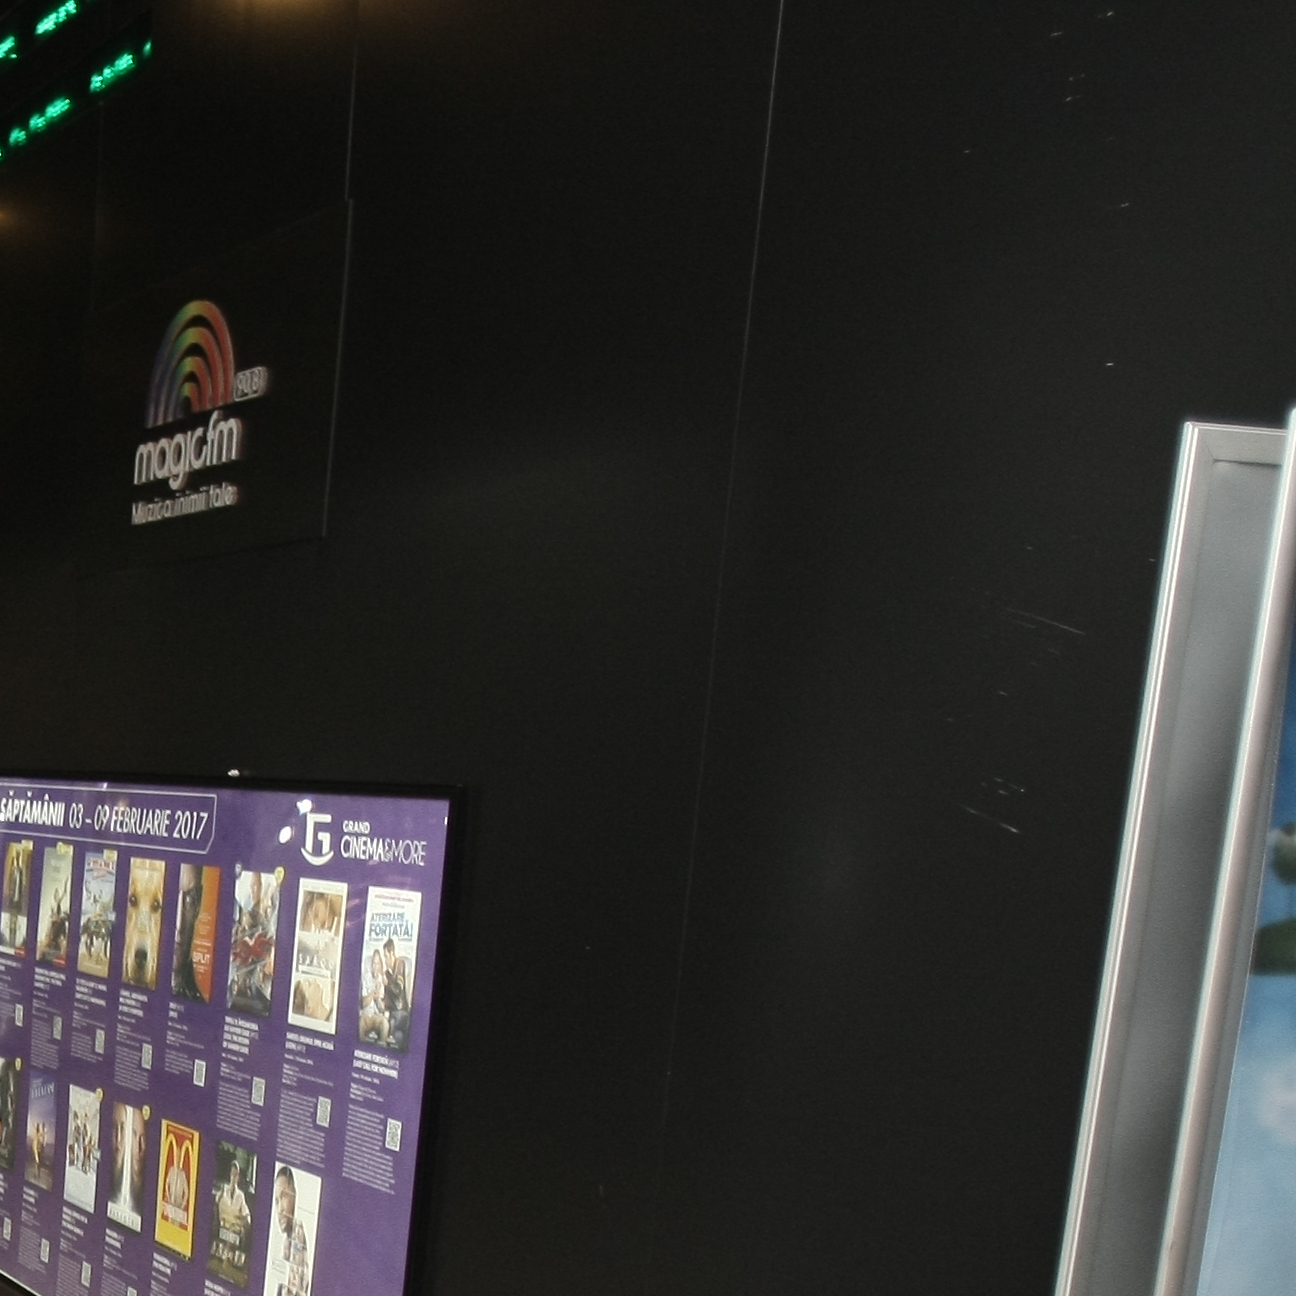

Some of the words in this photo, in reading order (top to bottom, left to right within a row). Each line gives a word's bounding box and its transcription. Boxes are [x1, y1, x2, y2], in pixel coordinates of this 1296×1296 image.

[209, 481, 239, 508] tale
[68, 803, 83, 830] 03
[93, 805, 110, 832] 09
[110, 805, 172, 838] FEBRUARIE
[172, 809, 210, 841] 2017
[342, 819, 371, 834] GRAND
